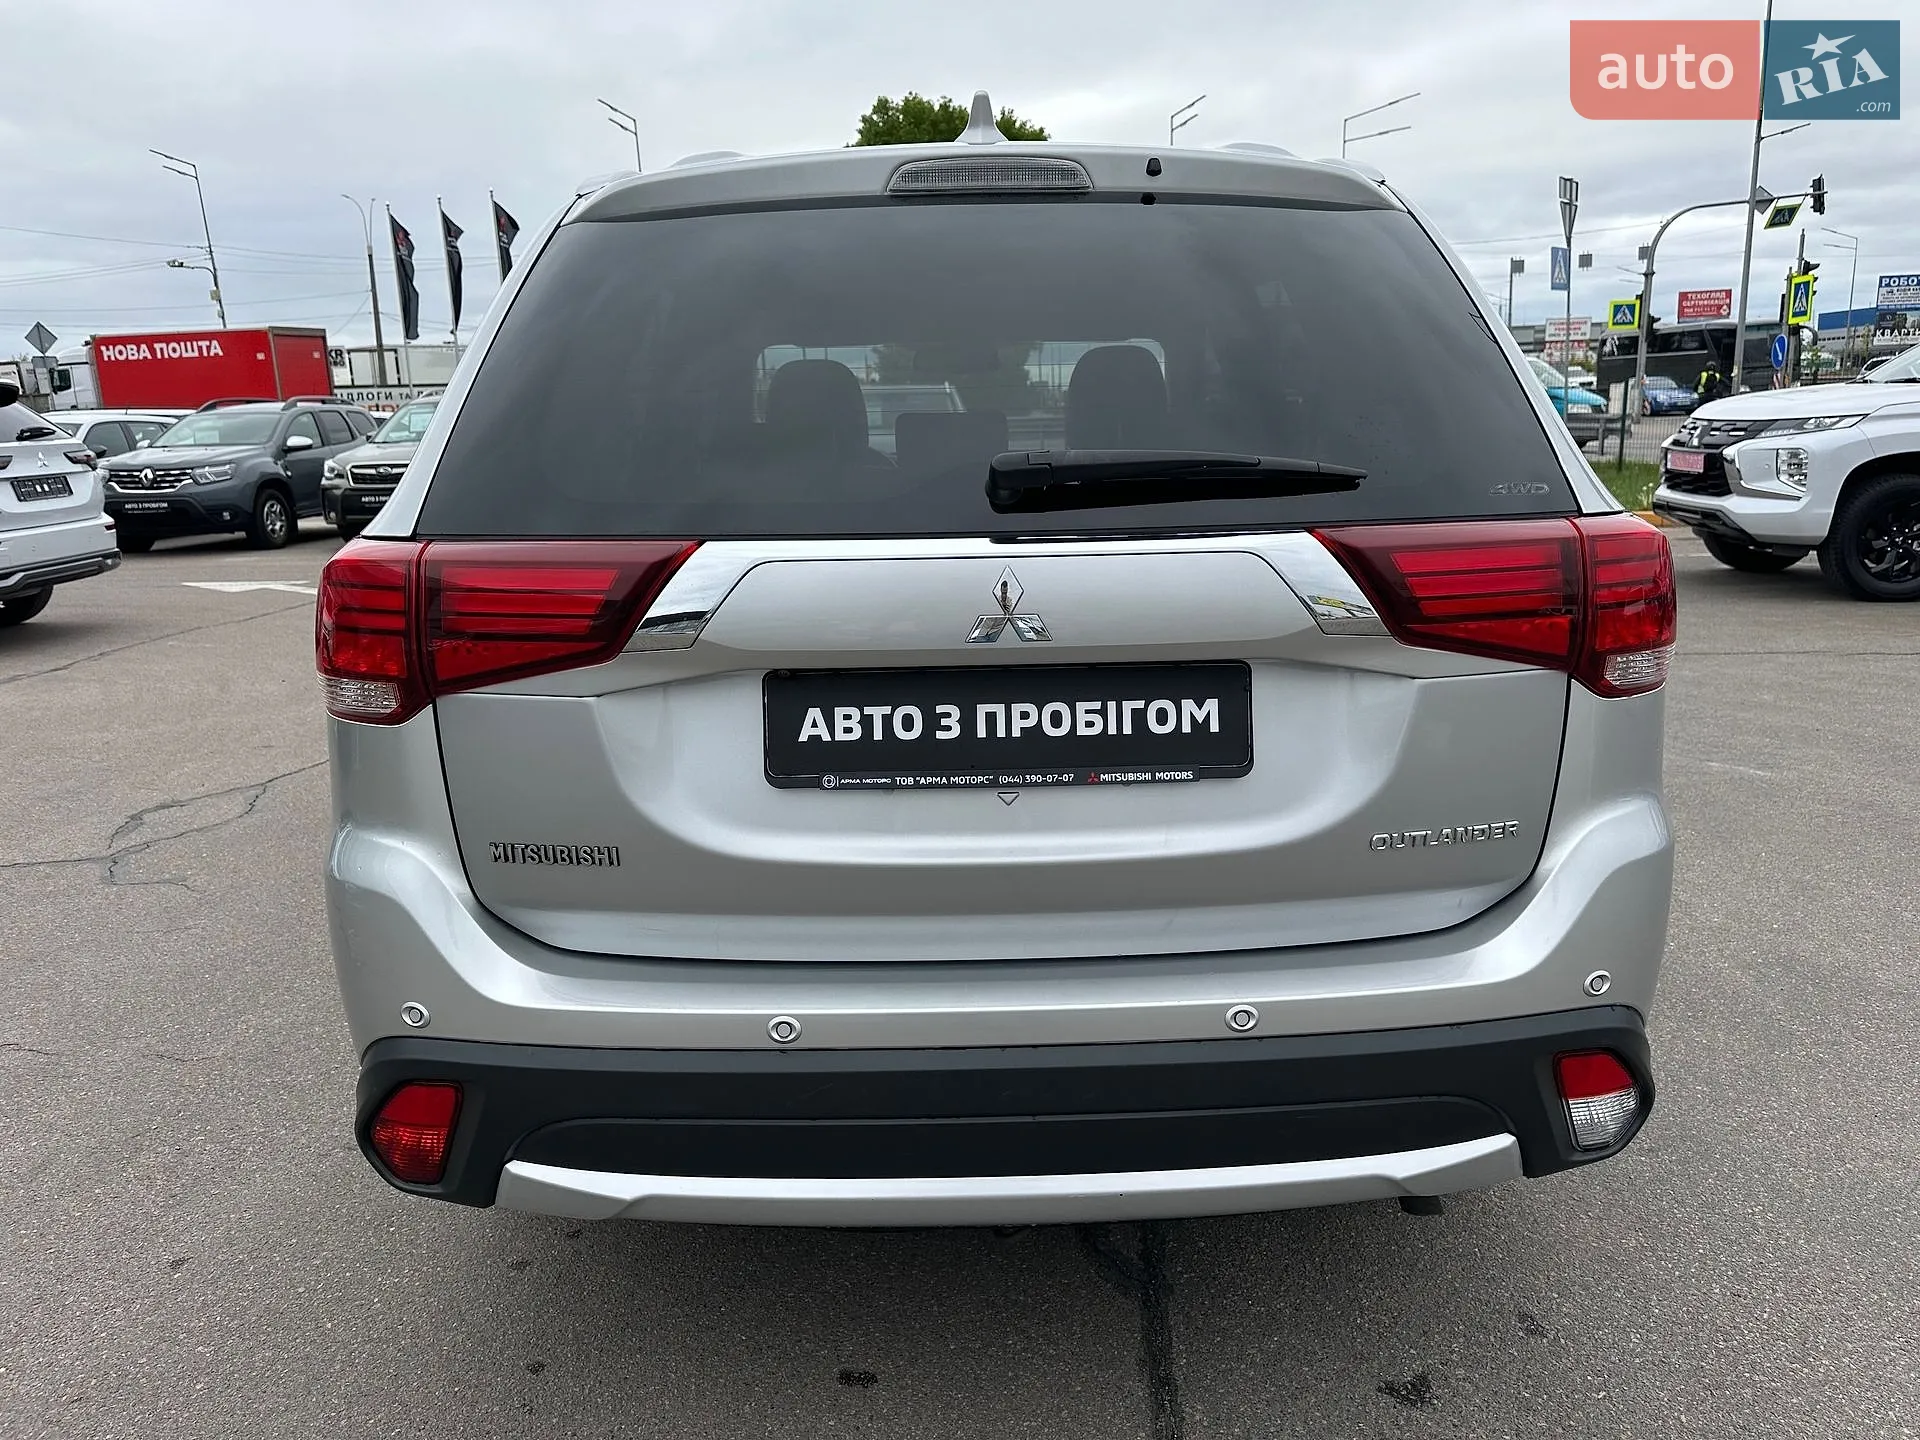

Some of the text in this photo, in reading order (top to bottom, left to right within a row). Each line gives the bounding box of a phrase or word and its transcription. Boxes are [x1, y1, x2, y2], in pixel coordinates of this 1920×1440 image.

[1881, 276, 1920, 287] РОБО
[100, 339, 223, 361] НОВА ПОШТА
[1489, 482, 1550, 495] 4WD
[798, 704, 924, 742] АВТО
[976, 698, 1220, 739] ПРОБІГОМ
[895, 776, 914, 786] ТОВ
[999, 774, 1023, 785] (044)
[1025, 773, 1074, 784] 390-07-07
[1100, 771, 1194, 783] MITSUBISHI MOTORS
[1370, 819, 1520, 852] OUTLANDER
[489, 842, 621, 867] MITSUBISHI
